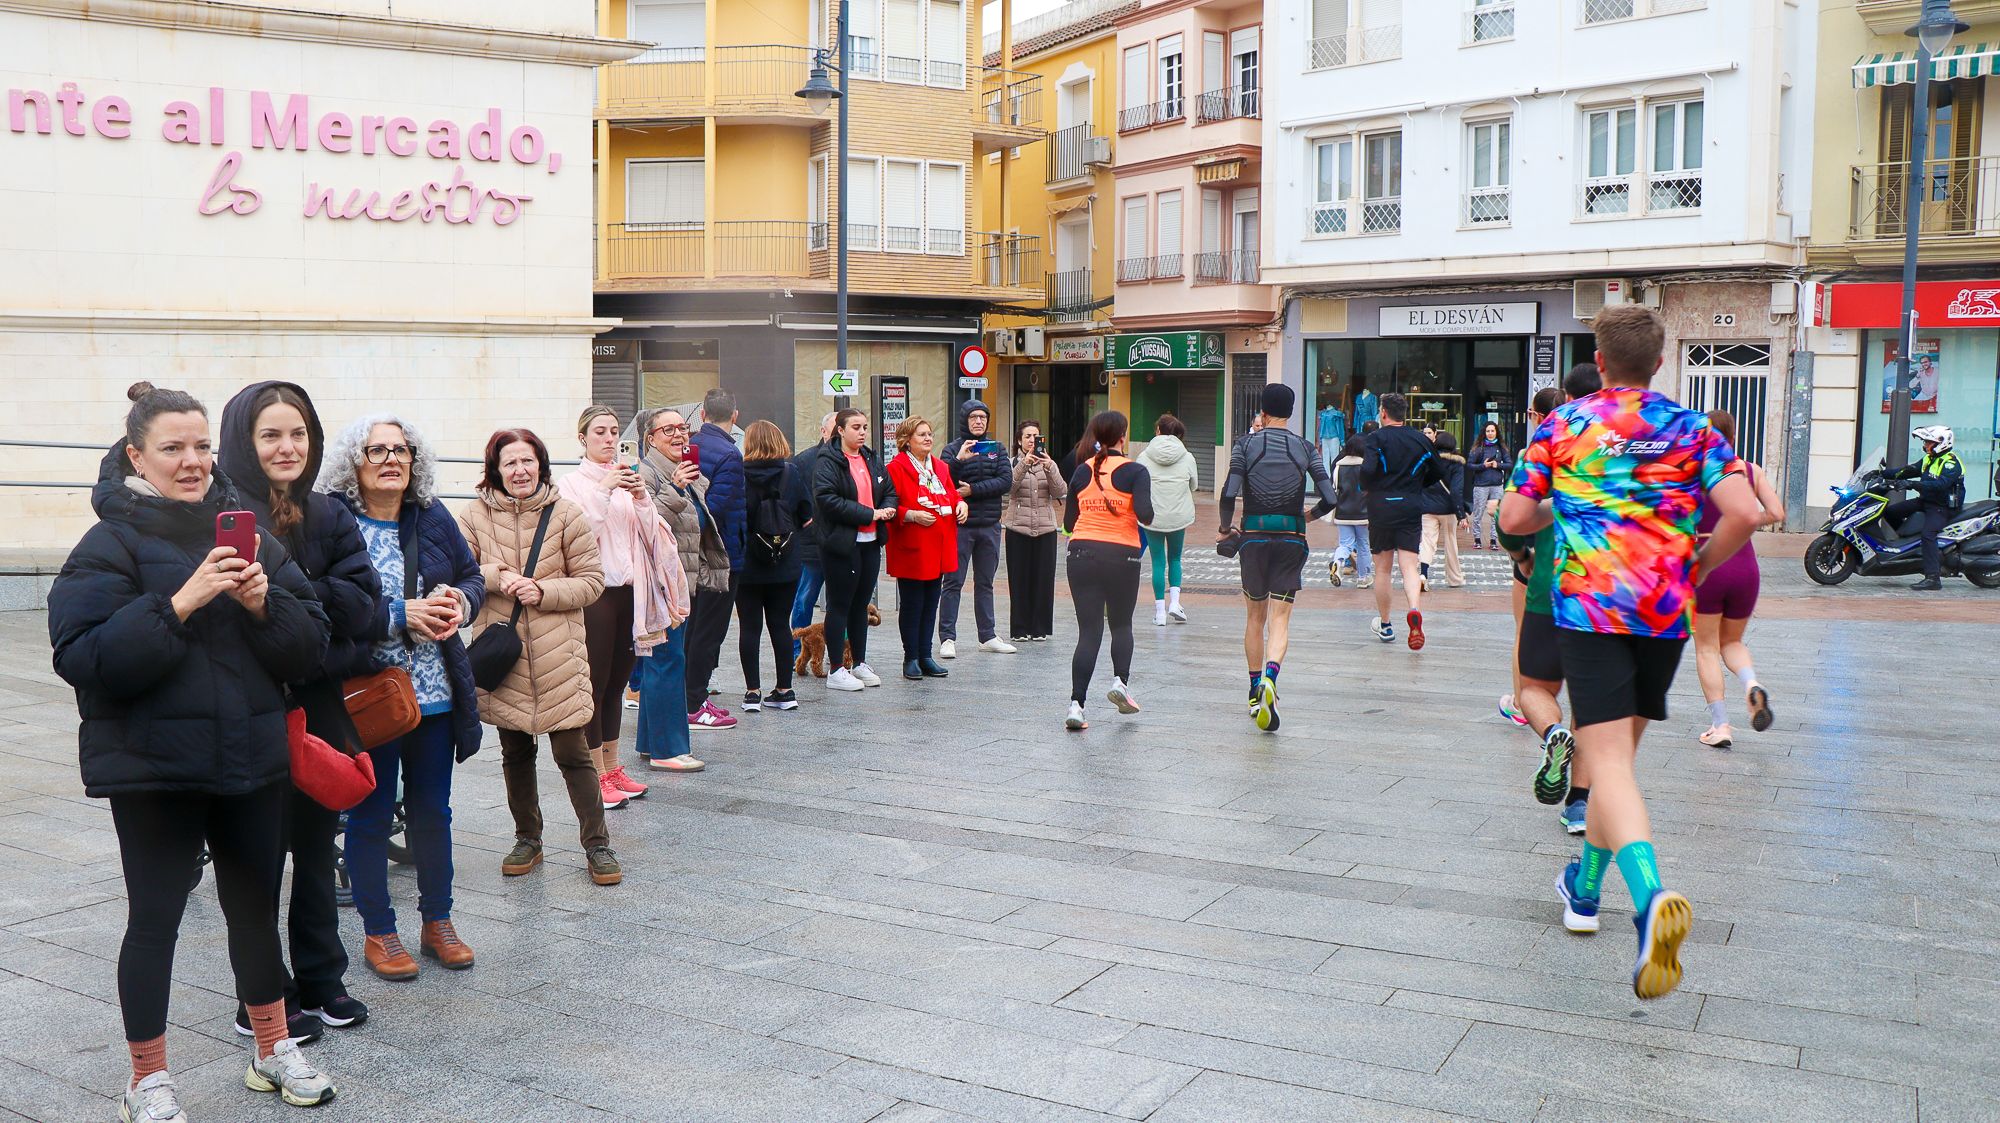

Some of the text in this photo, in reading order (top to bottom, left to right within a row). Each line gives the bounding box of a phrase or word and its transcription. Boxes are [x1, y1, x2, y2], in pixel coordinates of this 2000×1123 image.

[9, 82, 562, 174] nte al Mercado,
[199, 152, 534, 226] lo nuestro
[1409, 305, 1505, 326] EL DESVÁN
[1714, 314, 1733, 325] 20
[1419, 326, 1436, 334] MODA
[1442, 325, 1493, 334] COMPLEMENTOS
[1244, 338, 1250, 347] 2
[1130, 343, 1170, 362] AL-YUSSANA
[1630, 440, 1670, 450] SOM
